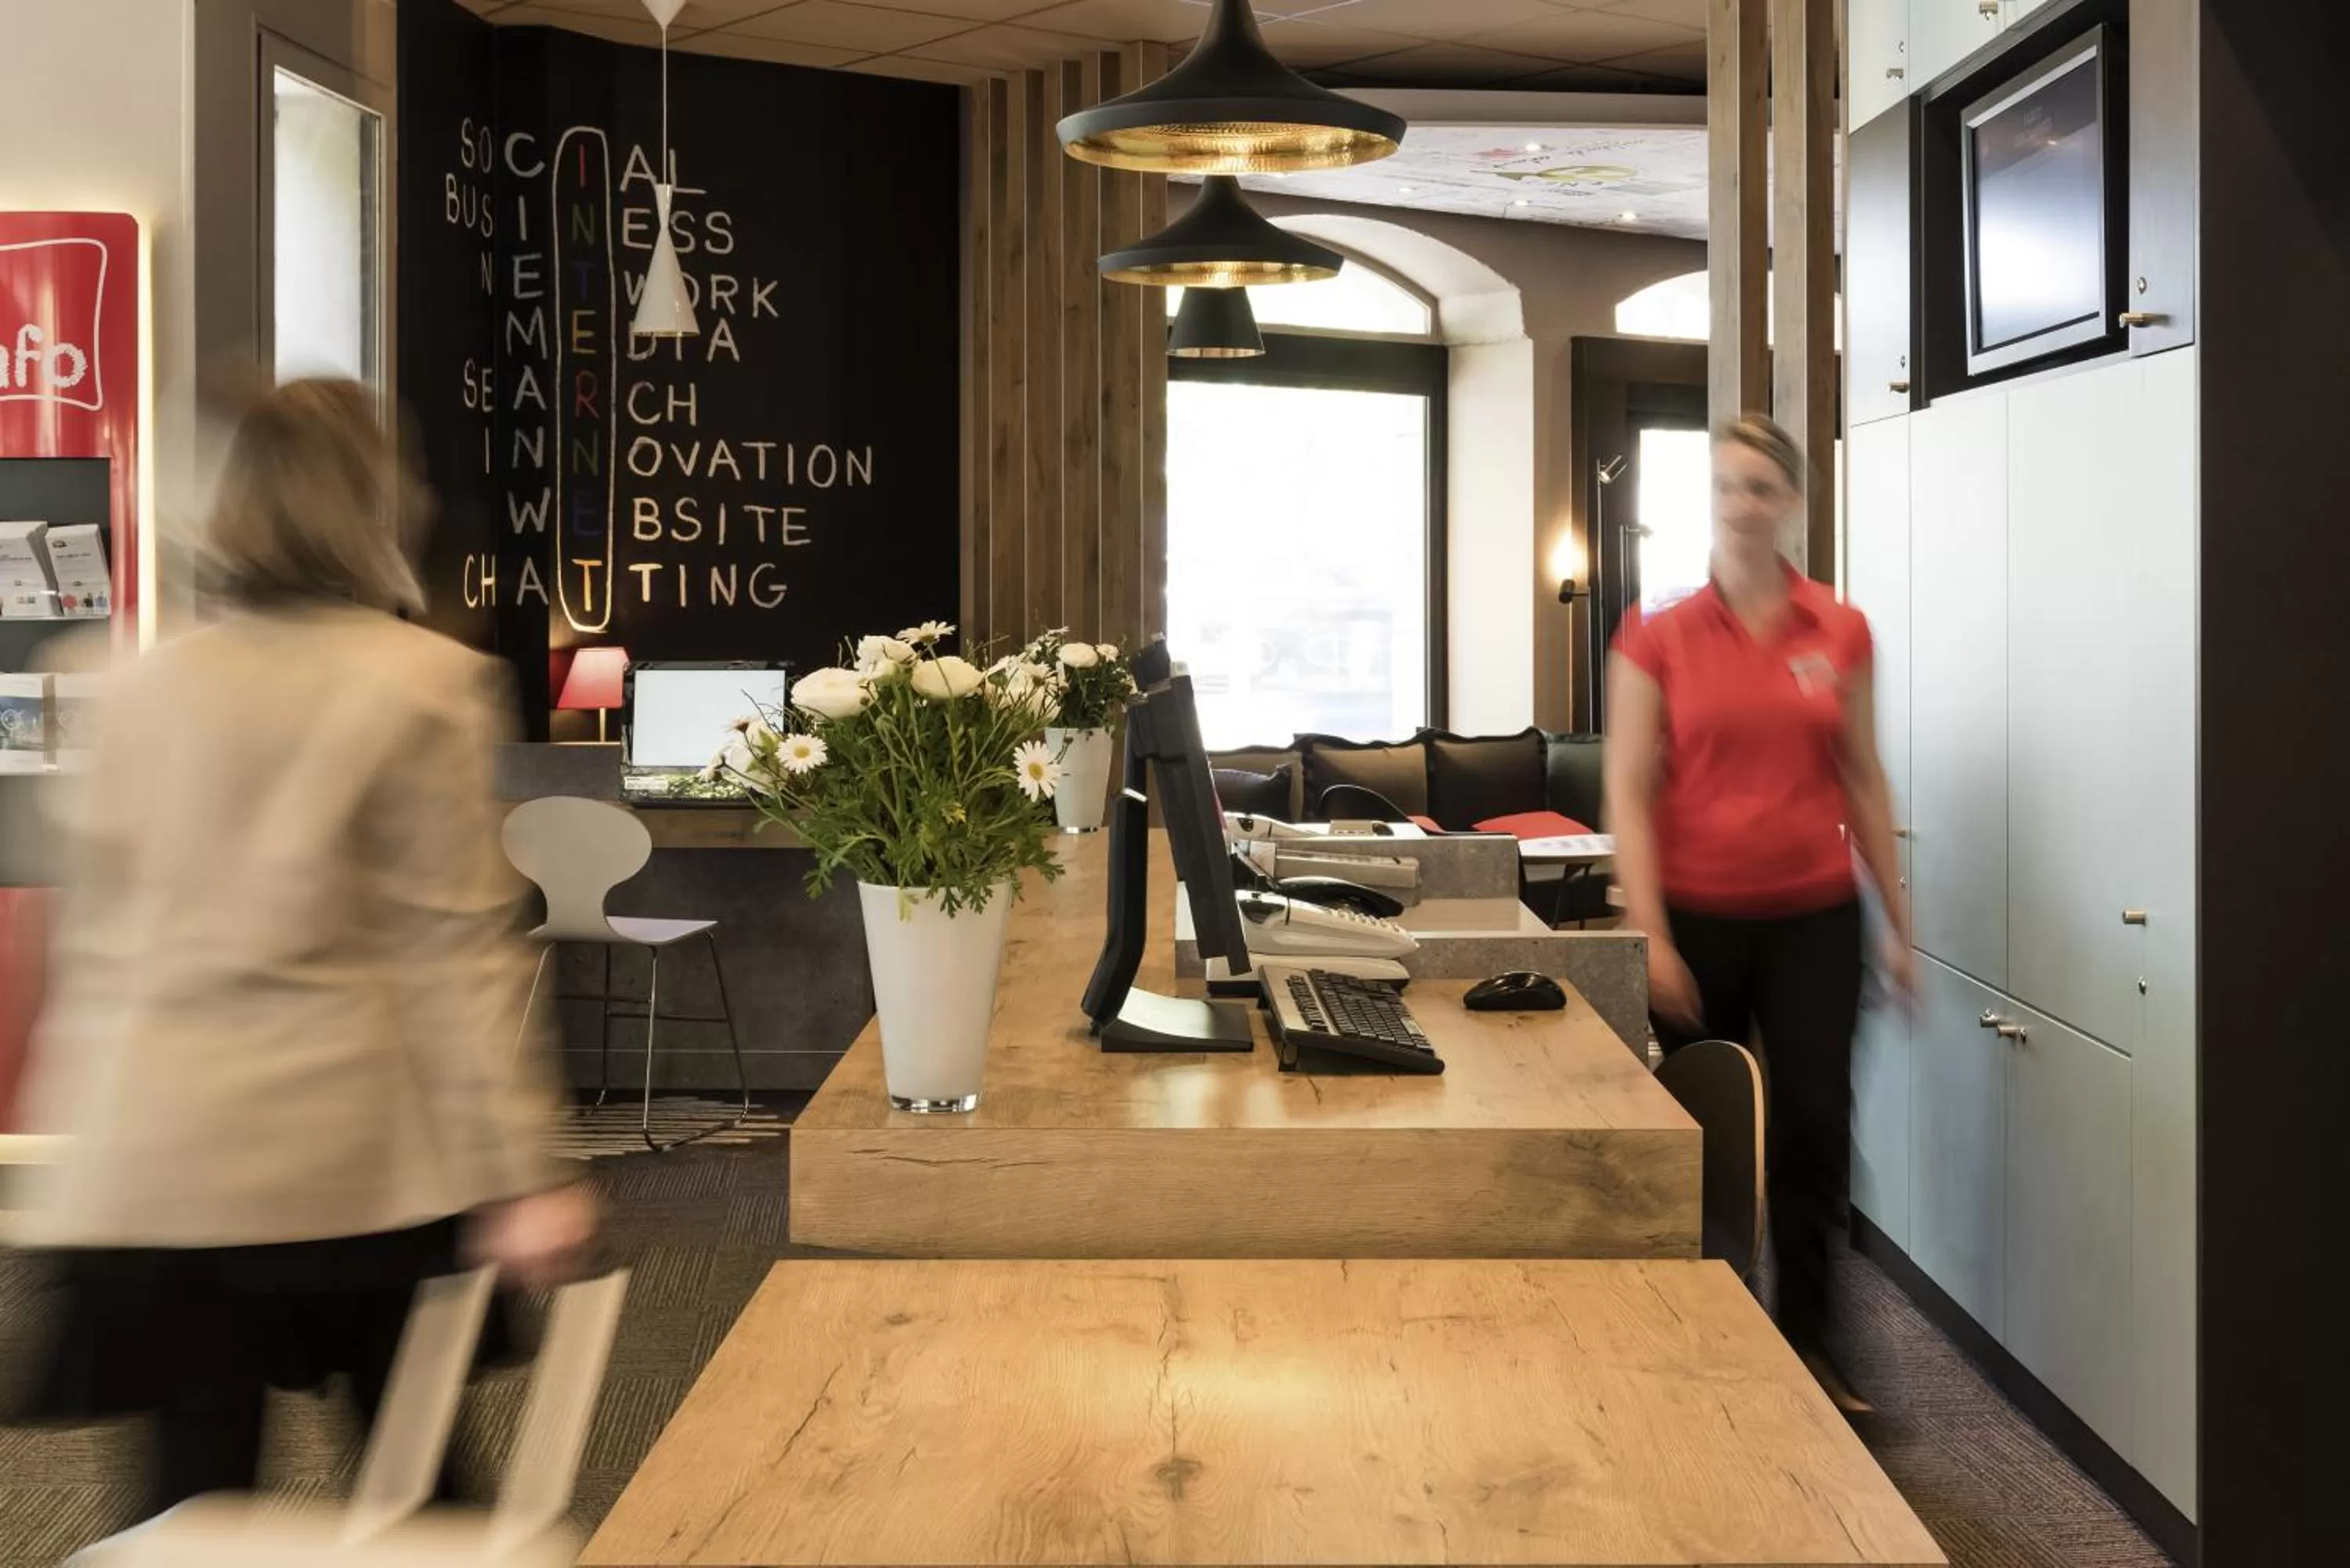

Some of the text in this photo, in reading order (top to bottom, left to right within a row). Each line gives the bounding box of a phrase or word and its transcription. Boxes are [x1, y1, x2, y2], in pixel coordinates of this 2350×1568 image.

[463, 358, 698, 427] SEARCH
[571, 143, 603, 612] INTERNET
[483, 426, 873, 487] INNOVATION
[463, 553, 787, 609] CHATTING
